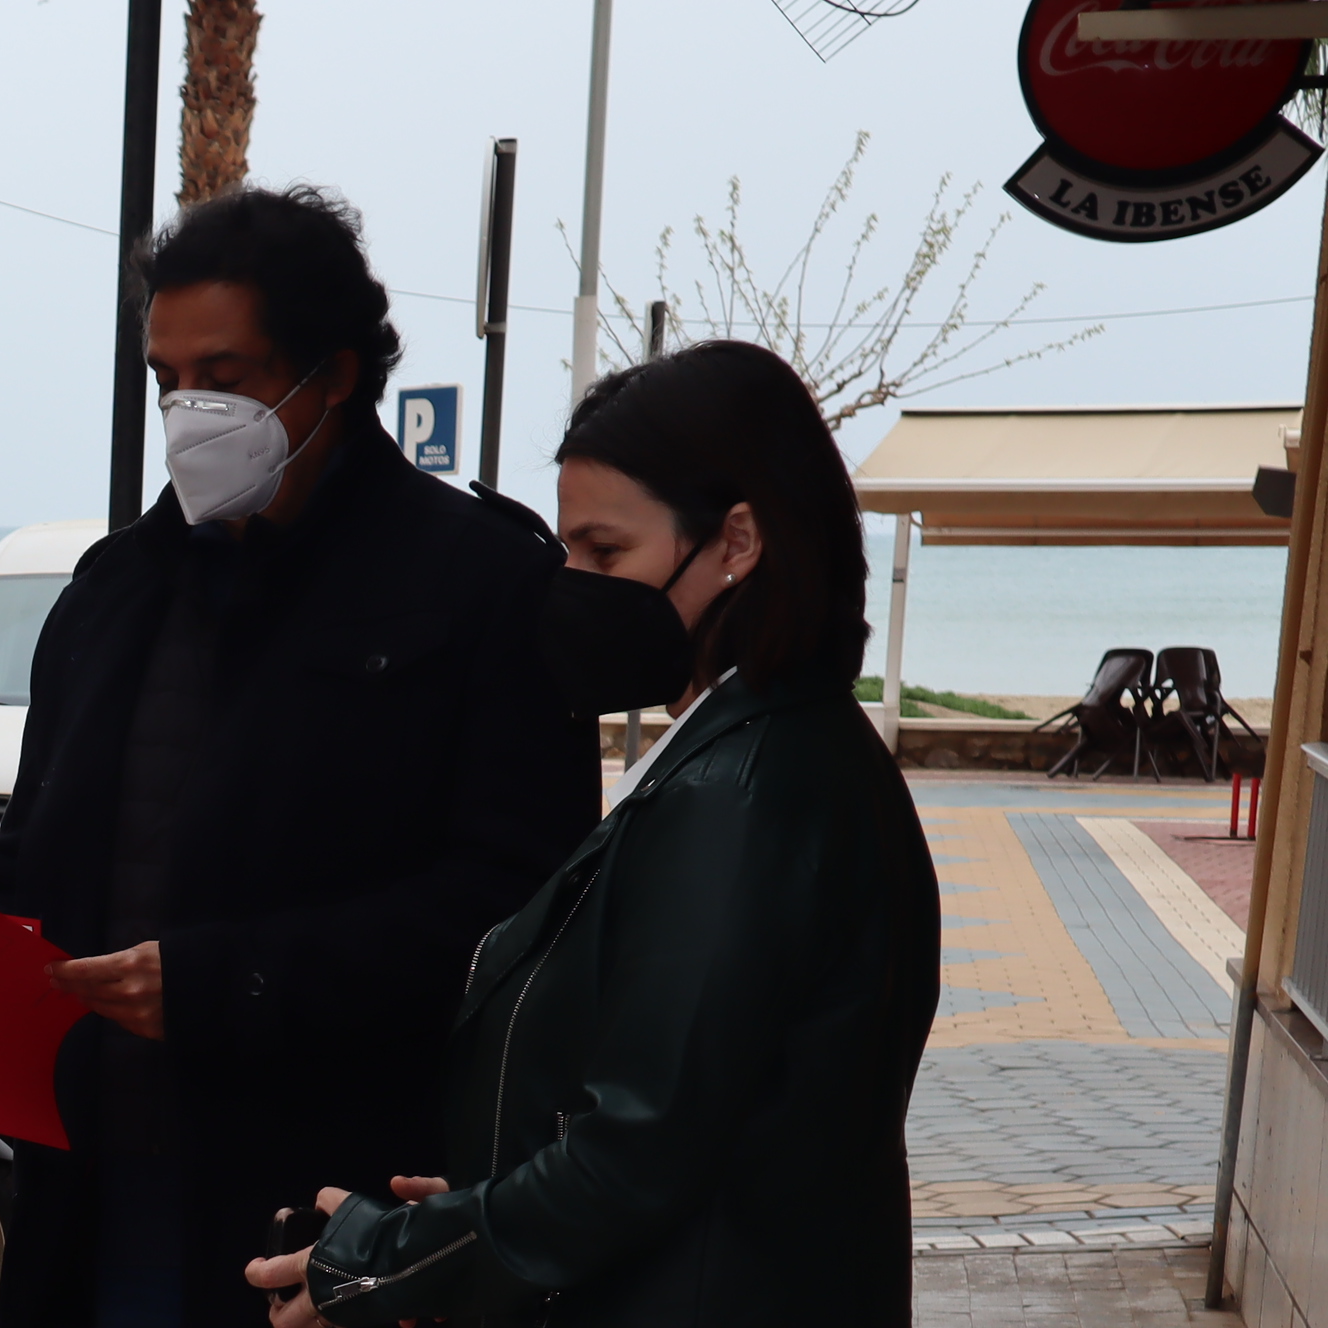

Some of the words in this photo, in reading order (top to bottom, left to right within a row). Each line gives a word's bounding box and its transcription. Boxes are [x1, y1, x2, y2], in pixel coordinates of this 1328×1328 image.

[1049, 178, 1099, 222] LA
[1112, 164, 1272, 228] IBENSE
[404, 397, 435, 467] P
[424, 444, 447, 455] SOLO
[418, 454, 451, 466] MOTOS
